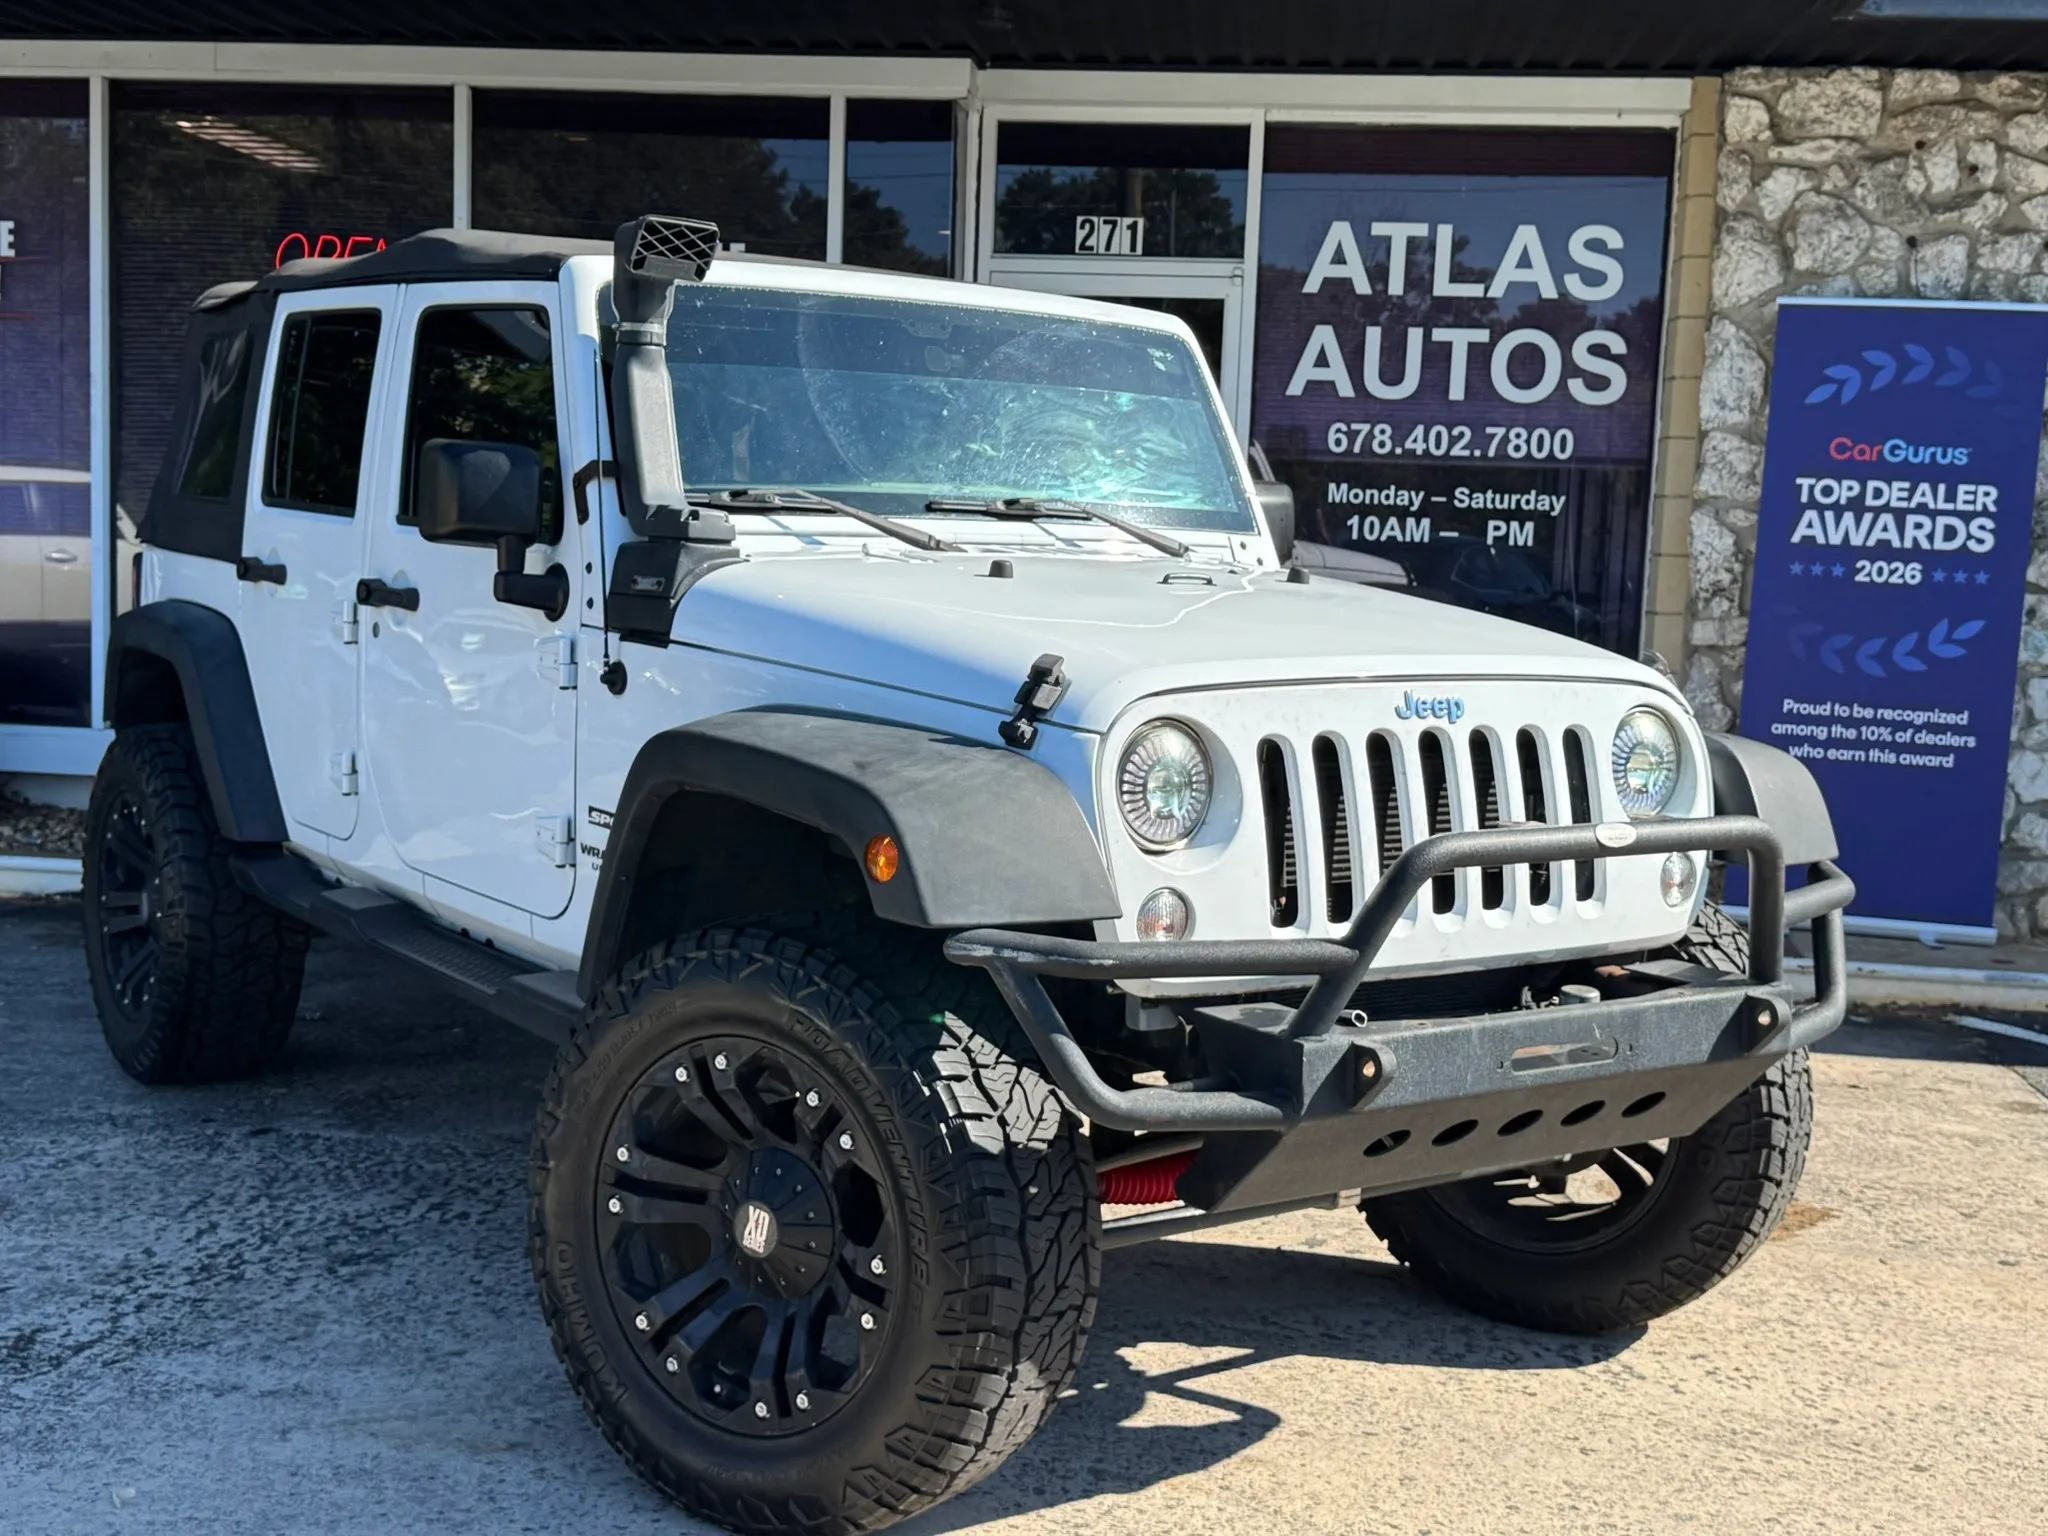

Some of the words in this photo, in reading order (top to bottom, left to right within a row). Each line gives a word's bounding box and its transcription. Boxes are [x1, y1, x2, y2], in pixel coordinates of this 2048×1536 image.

[1078, 218, 1138, 253] 271
[1302, 221, 1625, 301] ATLAS
[1286, 324, 1628, 405] AUTOS
[1327, 423, 1574, 460] 678.402.7800
[1829, 437, 1969, 466] CarGurus
[1327, 483, 1425, 511] Monday
[1453, 486, 1566, 515] Saturday
[1796, 477, 1860, 505] TOP
[1865, 480, 1999, 512] DEALER
[1346, 515, 1431, 543] 10AM
[1486, 520, 1535, 546] PM
[1790, 509, 1997, 553] AWARDS
[1854, 560, 1923, 585] 2026
[1394, 689, 1465, 725] Jeep
[1782, 698, 1831, 716] Proud
[1833, 702, 1850, 717] to
[1852, 703, 1875, 719] be
[1877, 708, 1969, 725] recognized
[1771, 723, 1828, 740] among
[1831, 723, 1857, 739] the
[1859, 725, 1893, 742] 10%
[1895, 728, 1914, 743] of
[1914, 729, 1976, 748] dealers
[1788, 743, 1825, 759] who
[1827, 748, 1866, 762] earn
[1868, 748, 1897, 764] this
[1899, 753, 1954, 769] award
[553, 1240, 650, 1405] KUMHO
